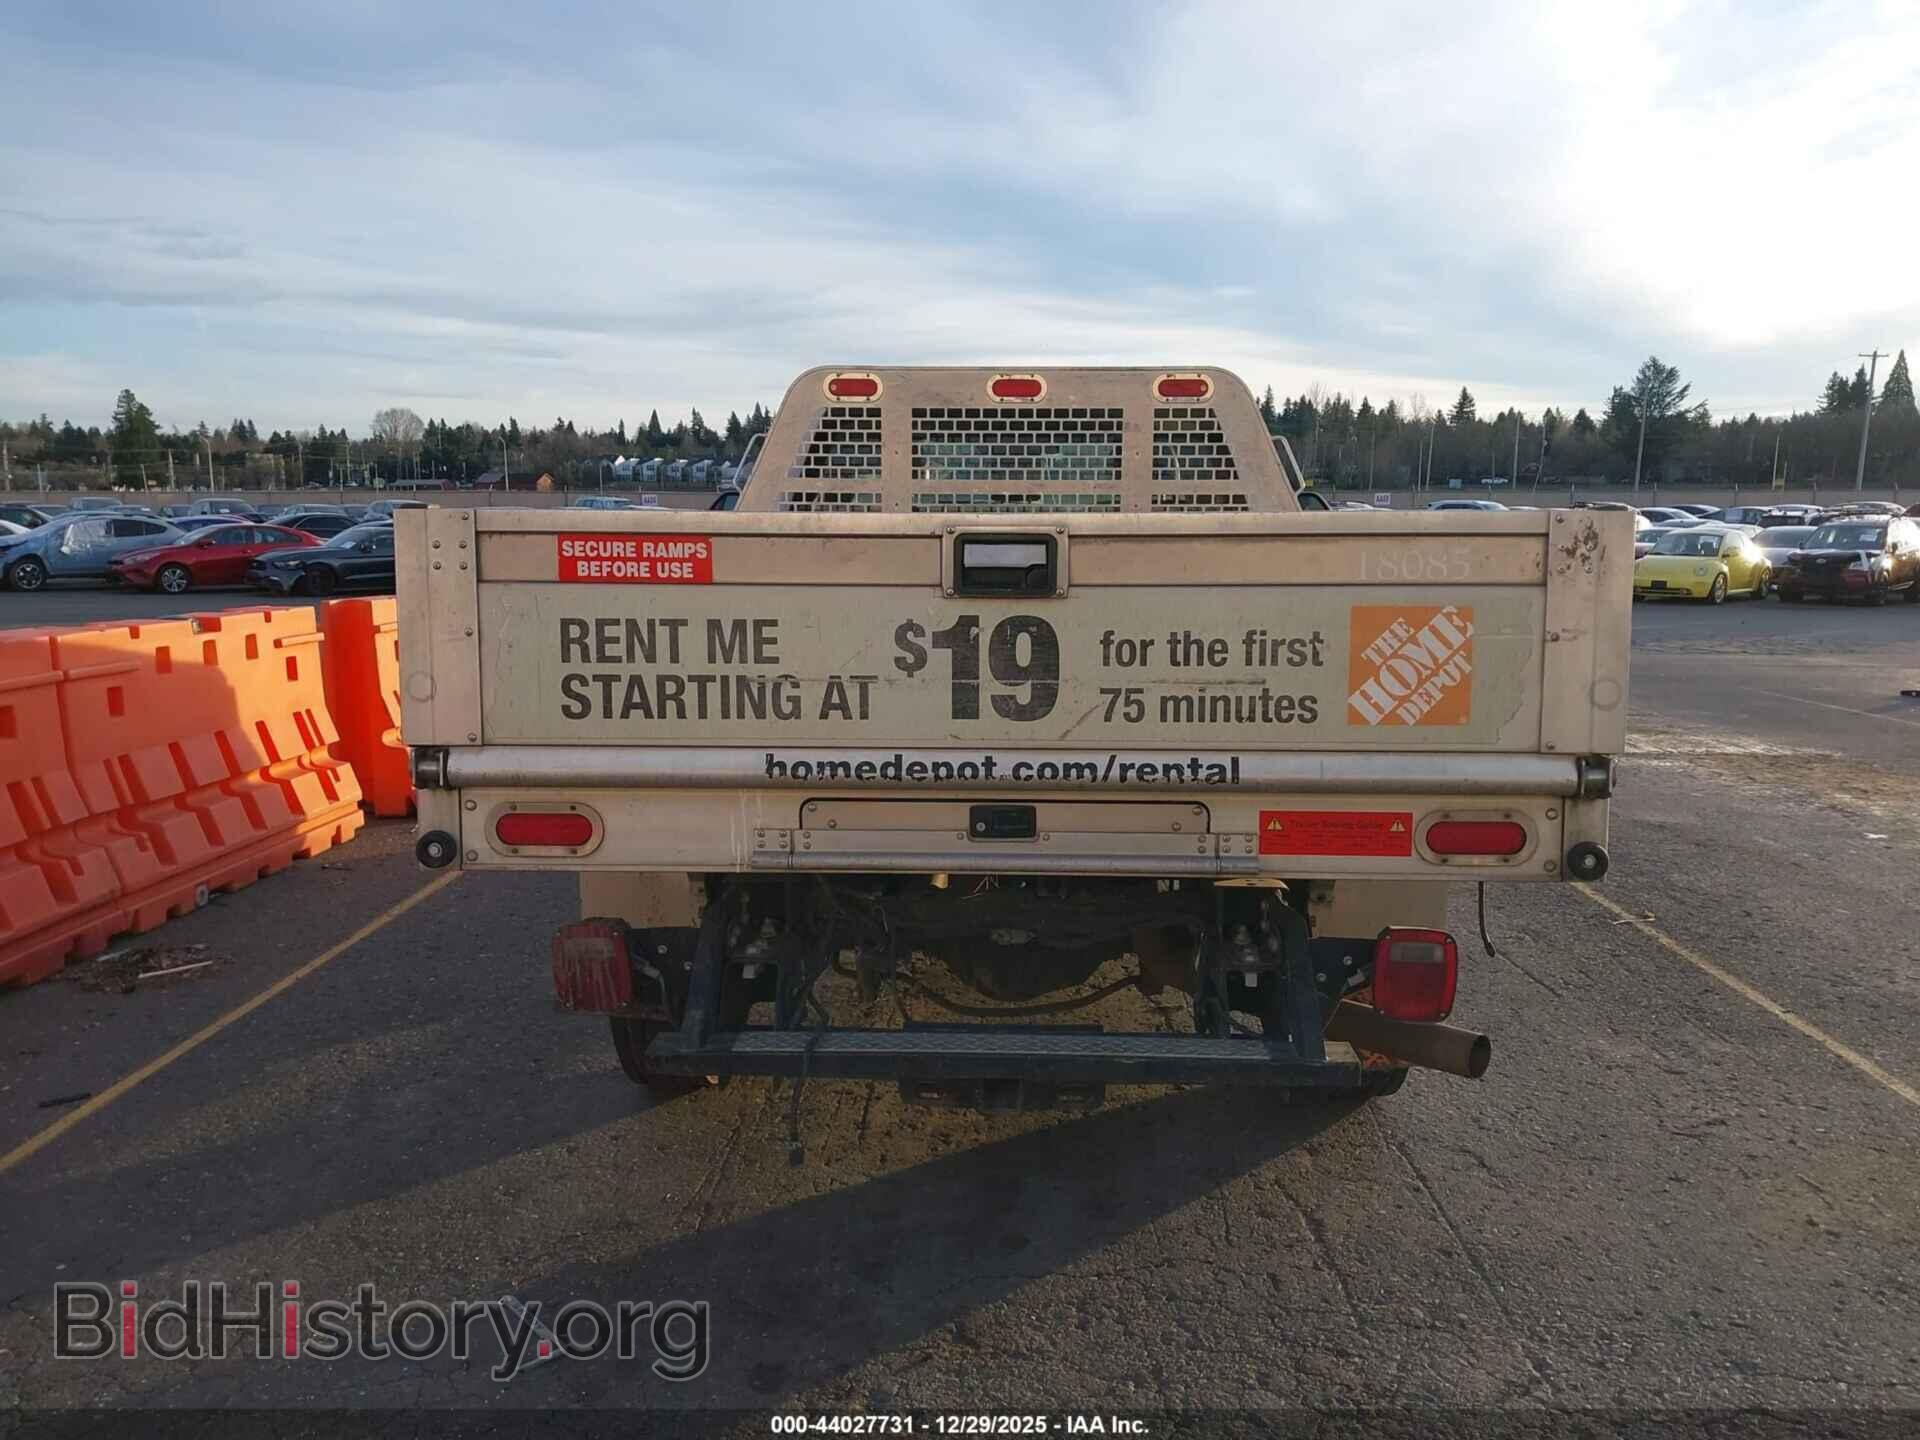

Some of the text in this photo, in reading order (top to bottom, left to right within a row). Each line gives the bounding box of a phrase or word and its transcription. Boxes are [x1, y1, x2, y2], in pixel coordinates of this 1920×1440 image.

[561, 540, 708, 559] SECURE RAMPS
[576, 560, 694, 578] BEFORE USE
[1356, 544, 1472, 581] 18085
[560, 618, 780, 665] RENT ME
[1100, 629, 1324, 668] for the first
[1361, 616, 1415, 666] THE
[894, 615, 1060, 721] $19
[1348, 606, 1475, 726] HOME
[1396, 650, 1472, 727] DEPOT
[561, 673, 878, 721] STARTING AT
[1099, 688, 1319, 724] 75 minutes
